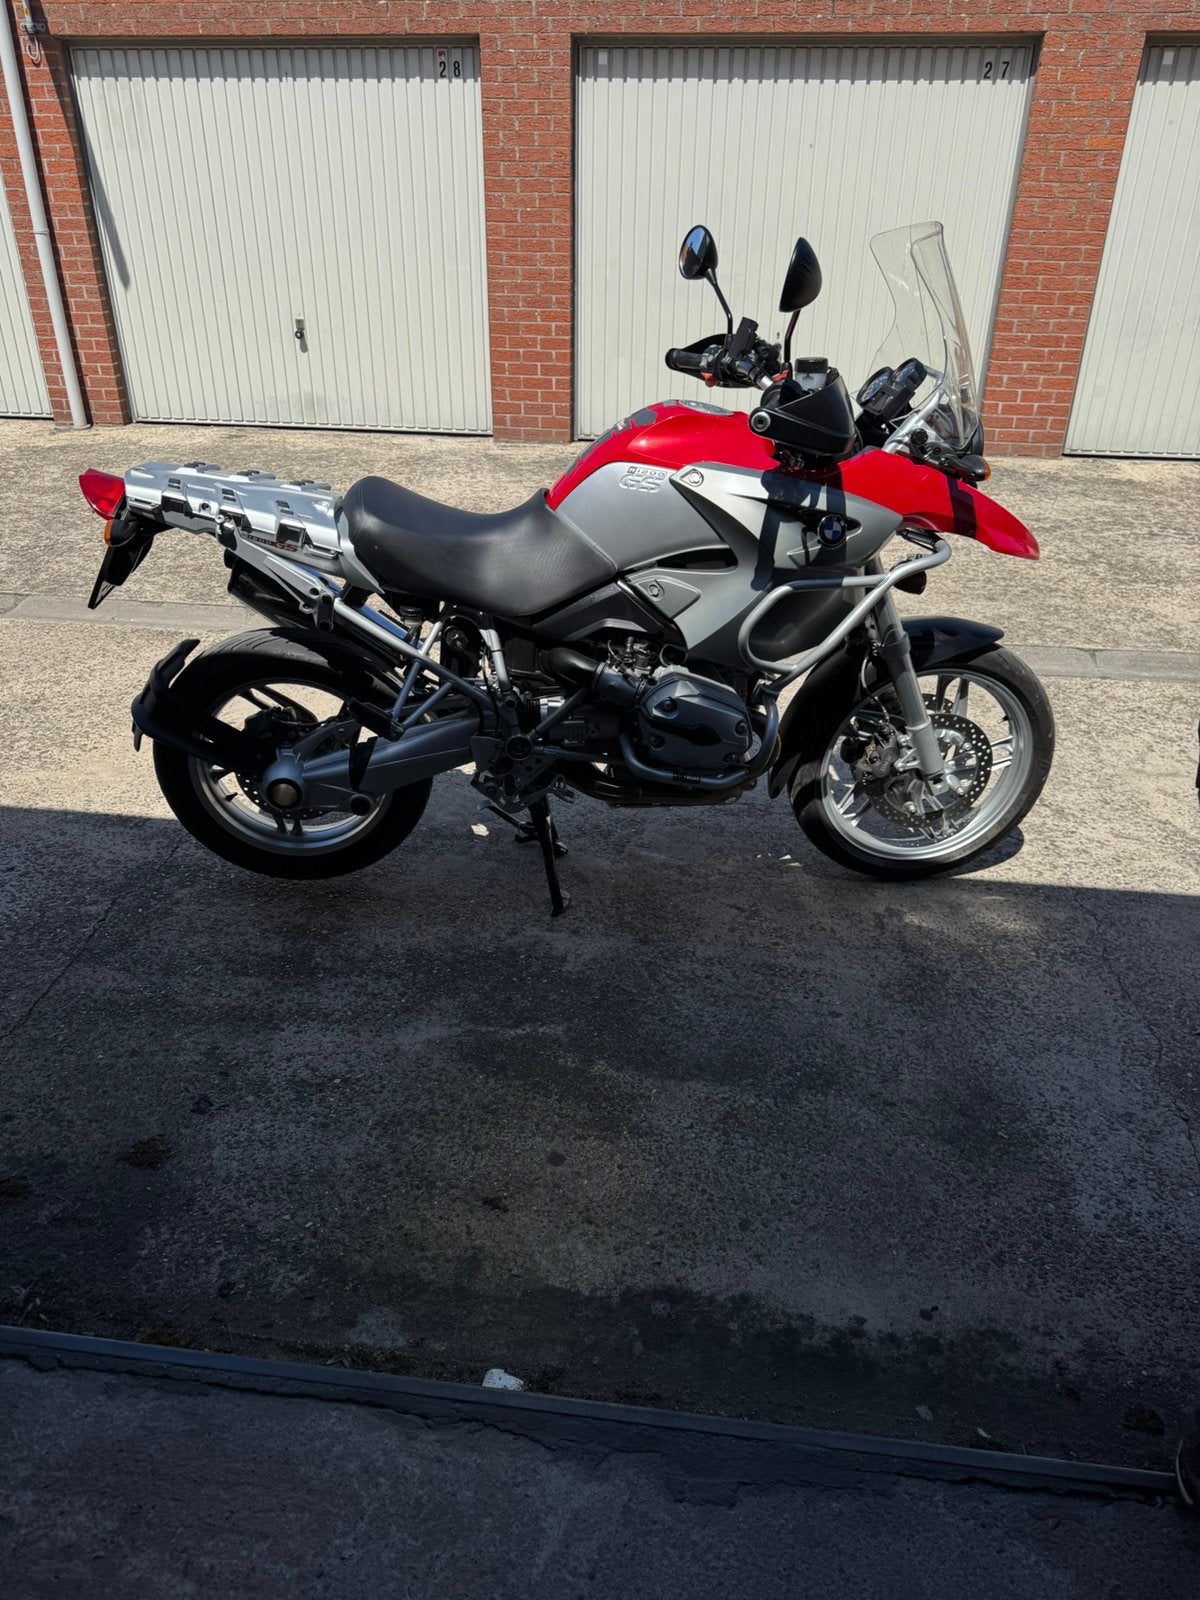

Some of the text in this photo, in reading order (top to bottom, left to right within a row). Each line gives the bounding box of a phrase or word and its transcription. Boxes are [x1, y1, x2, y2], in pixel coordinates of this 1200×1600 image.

[439, 61, 461, 78] 28
[983, 61, 1010, 79] 27
[620, 474, 661, 492] GS
